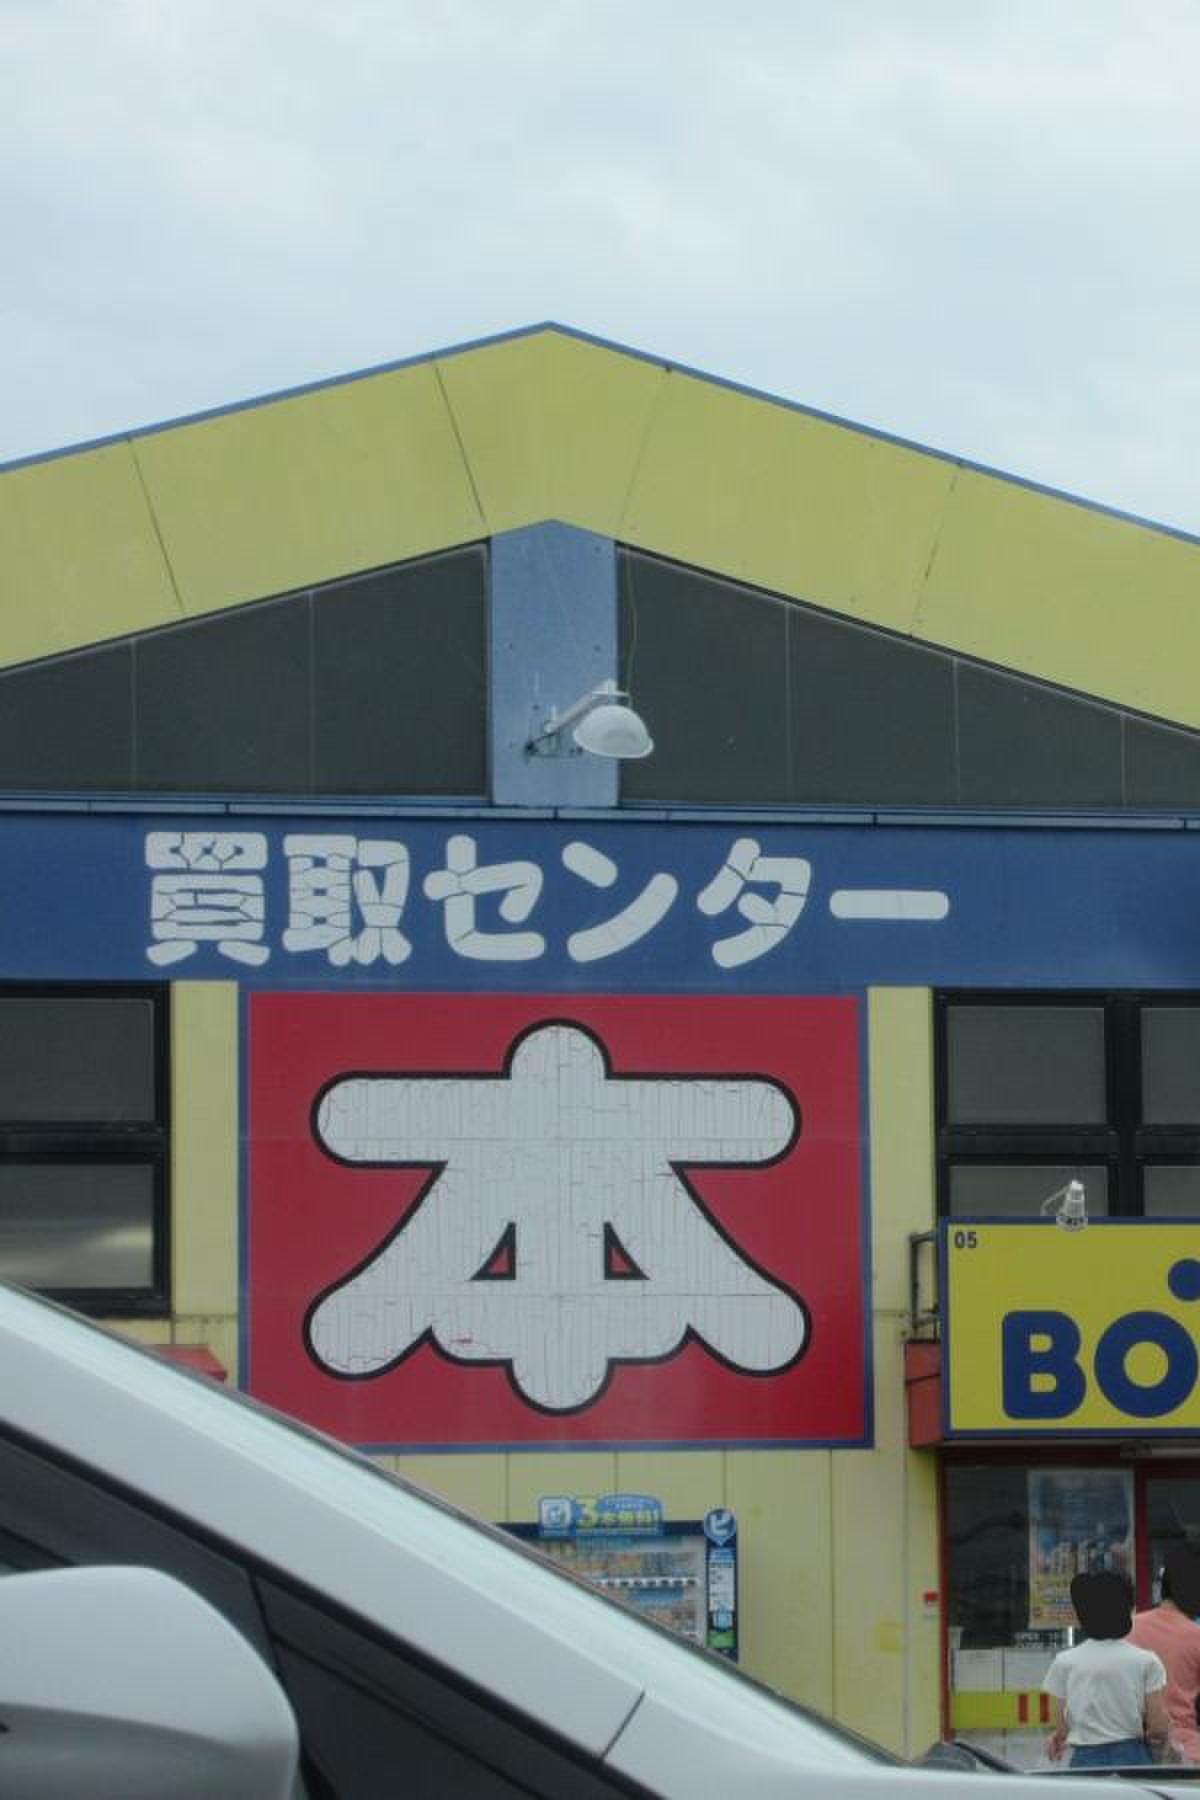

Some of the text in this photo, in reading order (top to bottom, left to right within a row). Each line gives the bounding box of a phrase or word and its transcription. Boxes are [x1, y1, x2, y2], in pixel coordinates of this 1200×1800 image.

[145, 831, 951, 968] 買取センター
[302, 1018, 812, 1416] 本
[953, 1231, 978, 1249] 05
